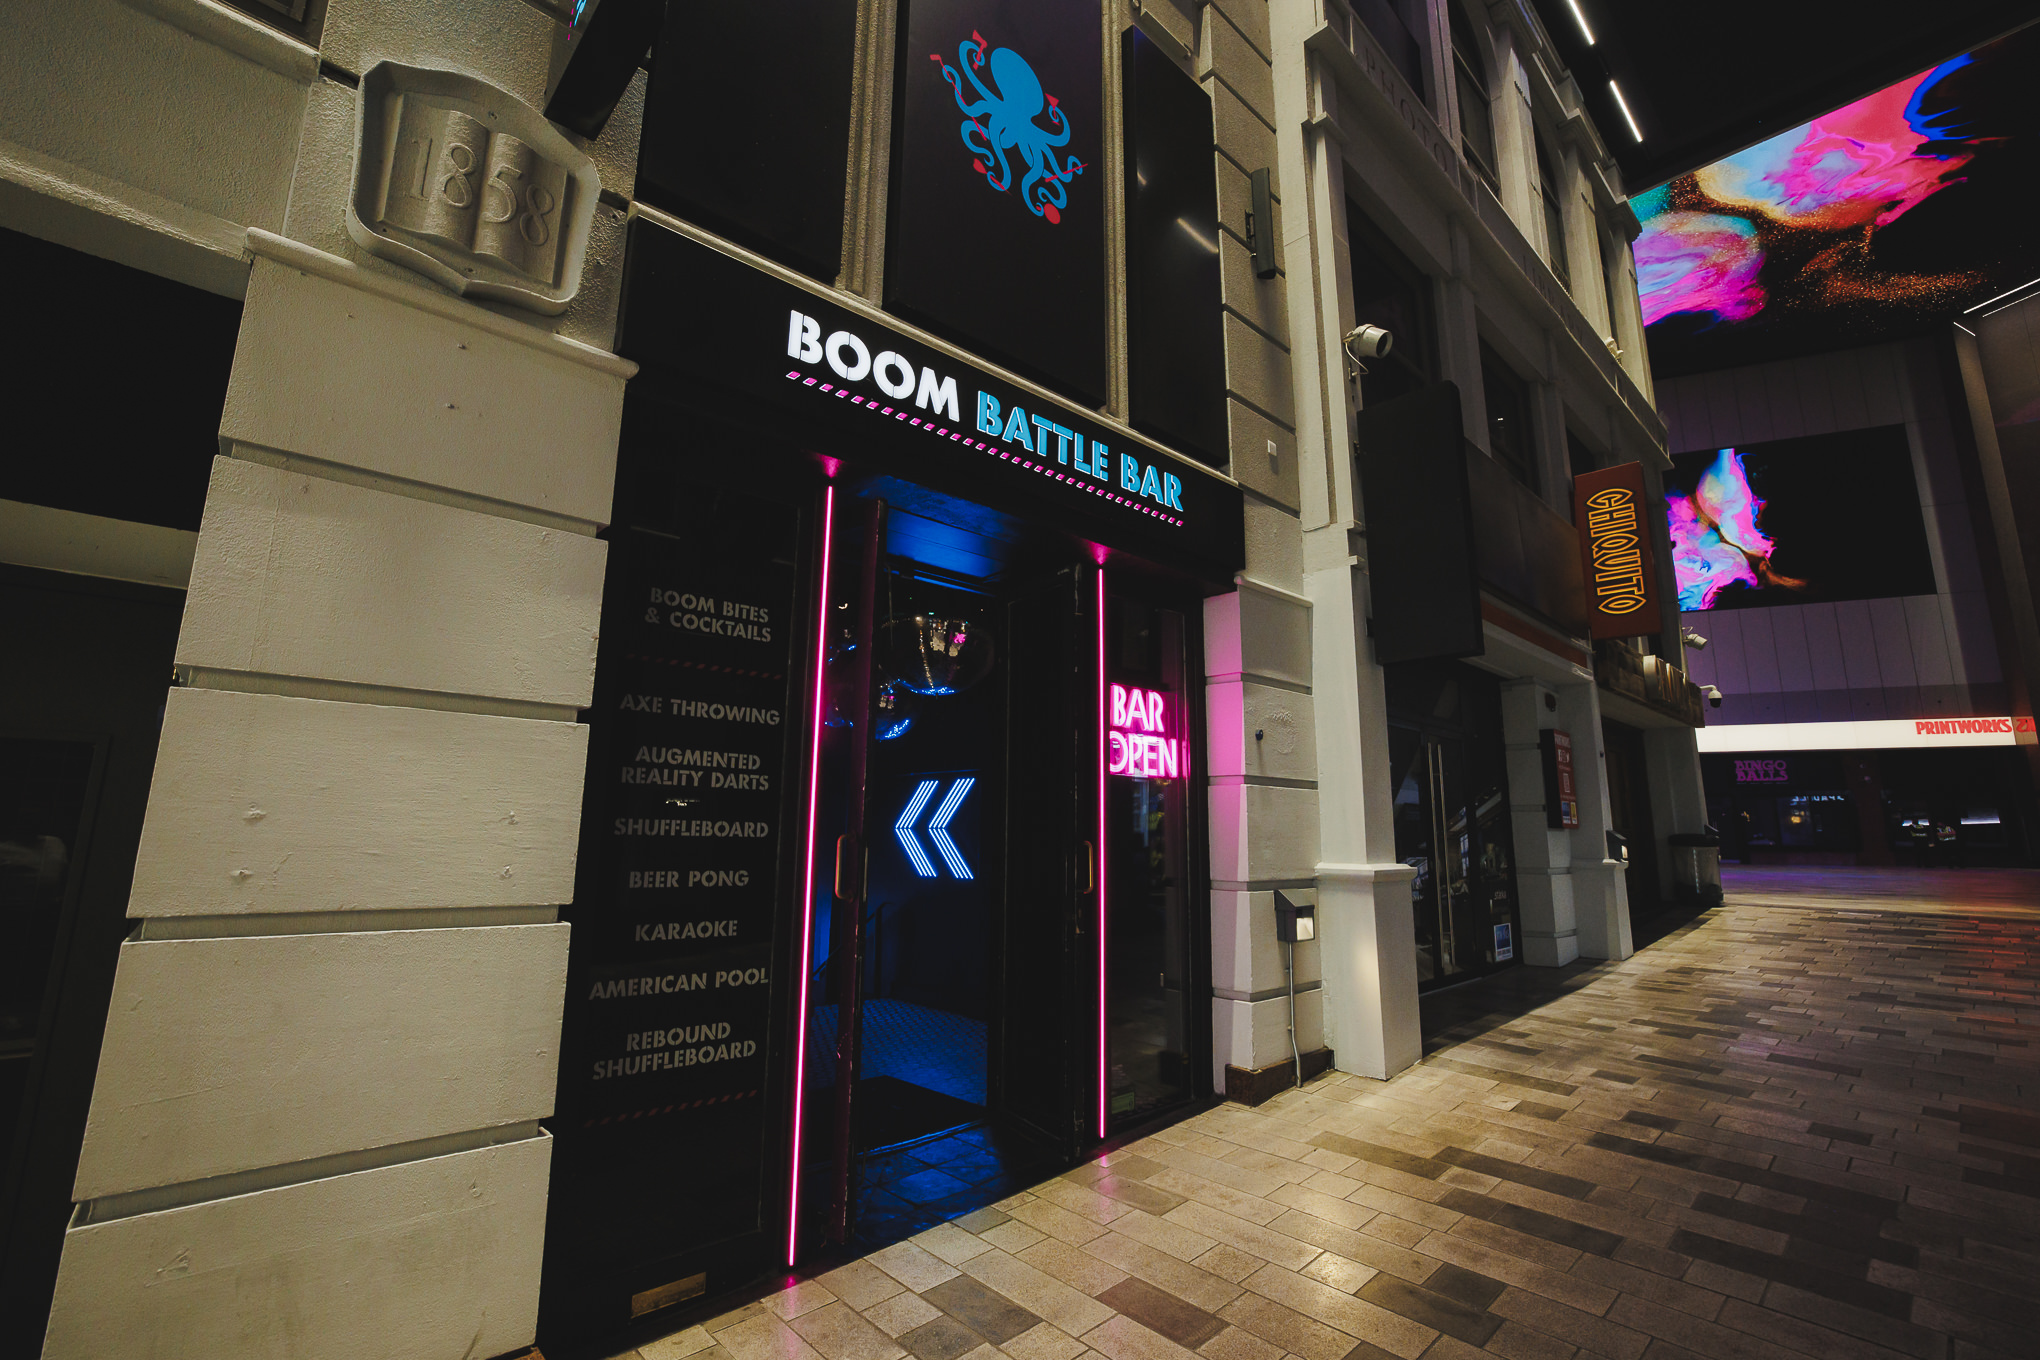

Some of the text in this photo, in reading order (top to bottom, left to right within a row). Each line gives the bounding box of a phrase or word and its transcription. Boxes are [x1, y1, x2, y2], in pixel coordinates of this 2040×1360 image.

[409, 138, 555, 247] 1858
[787, 309, 1185, 512] BOOM BATTLE BAR
[1586, 488, 1648, 615] CHIQUITO
[650, 586, 770, 624] BOOM BITES
[644, 607, 773, 643] & COCKTAILS
[619, 693, 781, 726] AXE THROWING
[1110, 684, 1165, 733] BAR
[1915, 718, 2013, 735] PRINTWORKS
[635, 745, 762, 771] AUGMENTED
[1109, 730, 1179, 779] OPEN
[1734, 759, 1787, 771] BINGO
[620, 766, 769, 791] REALITY DARTS
[1735, 770, 1789, 782] BALLS
[613, 817, 770, 839] SHUFFLEBOARD
[628, 870, 750, 889] BEER PONG
[634, 919, 738, 942] KARAOKE
[588, 967, 769, 1001] AMERICAN POOL
[626, 1021, 732, 1052] REBOUND
[592, 1039, 757, 1081] SHUFFLEBOARD
